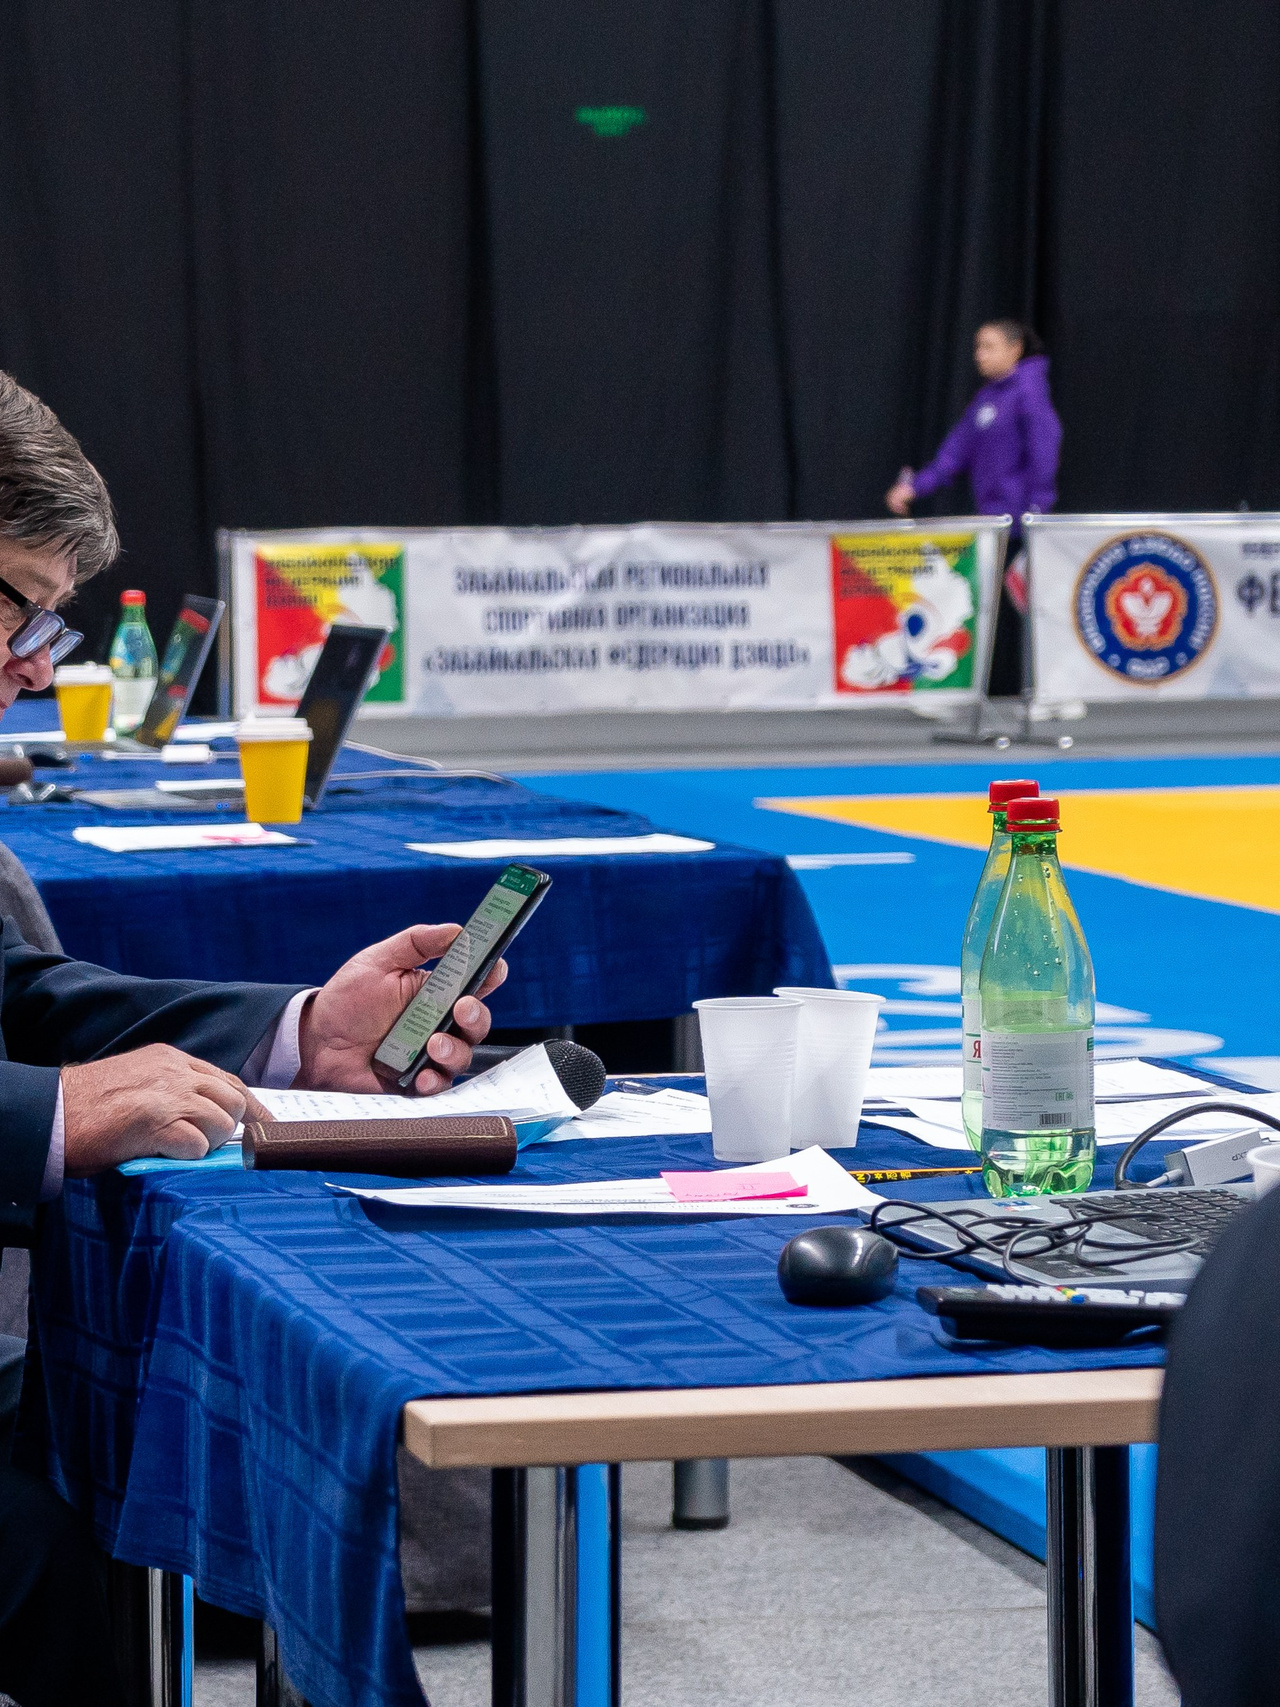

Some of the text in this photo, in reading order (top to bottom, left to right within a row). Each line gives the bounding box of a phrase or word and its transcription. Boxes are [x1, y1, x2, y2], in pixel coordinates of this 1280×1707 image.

[626, 563, 767, 590] РЕГИОНАЛЬНАЯ
[485, 603, 750, 633] СПОРТИВНАЯ ОРГАНИЗАЦИЯ
[609, 643, 723, 670] ФЕДЕРАЦИЯ
